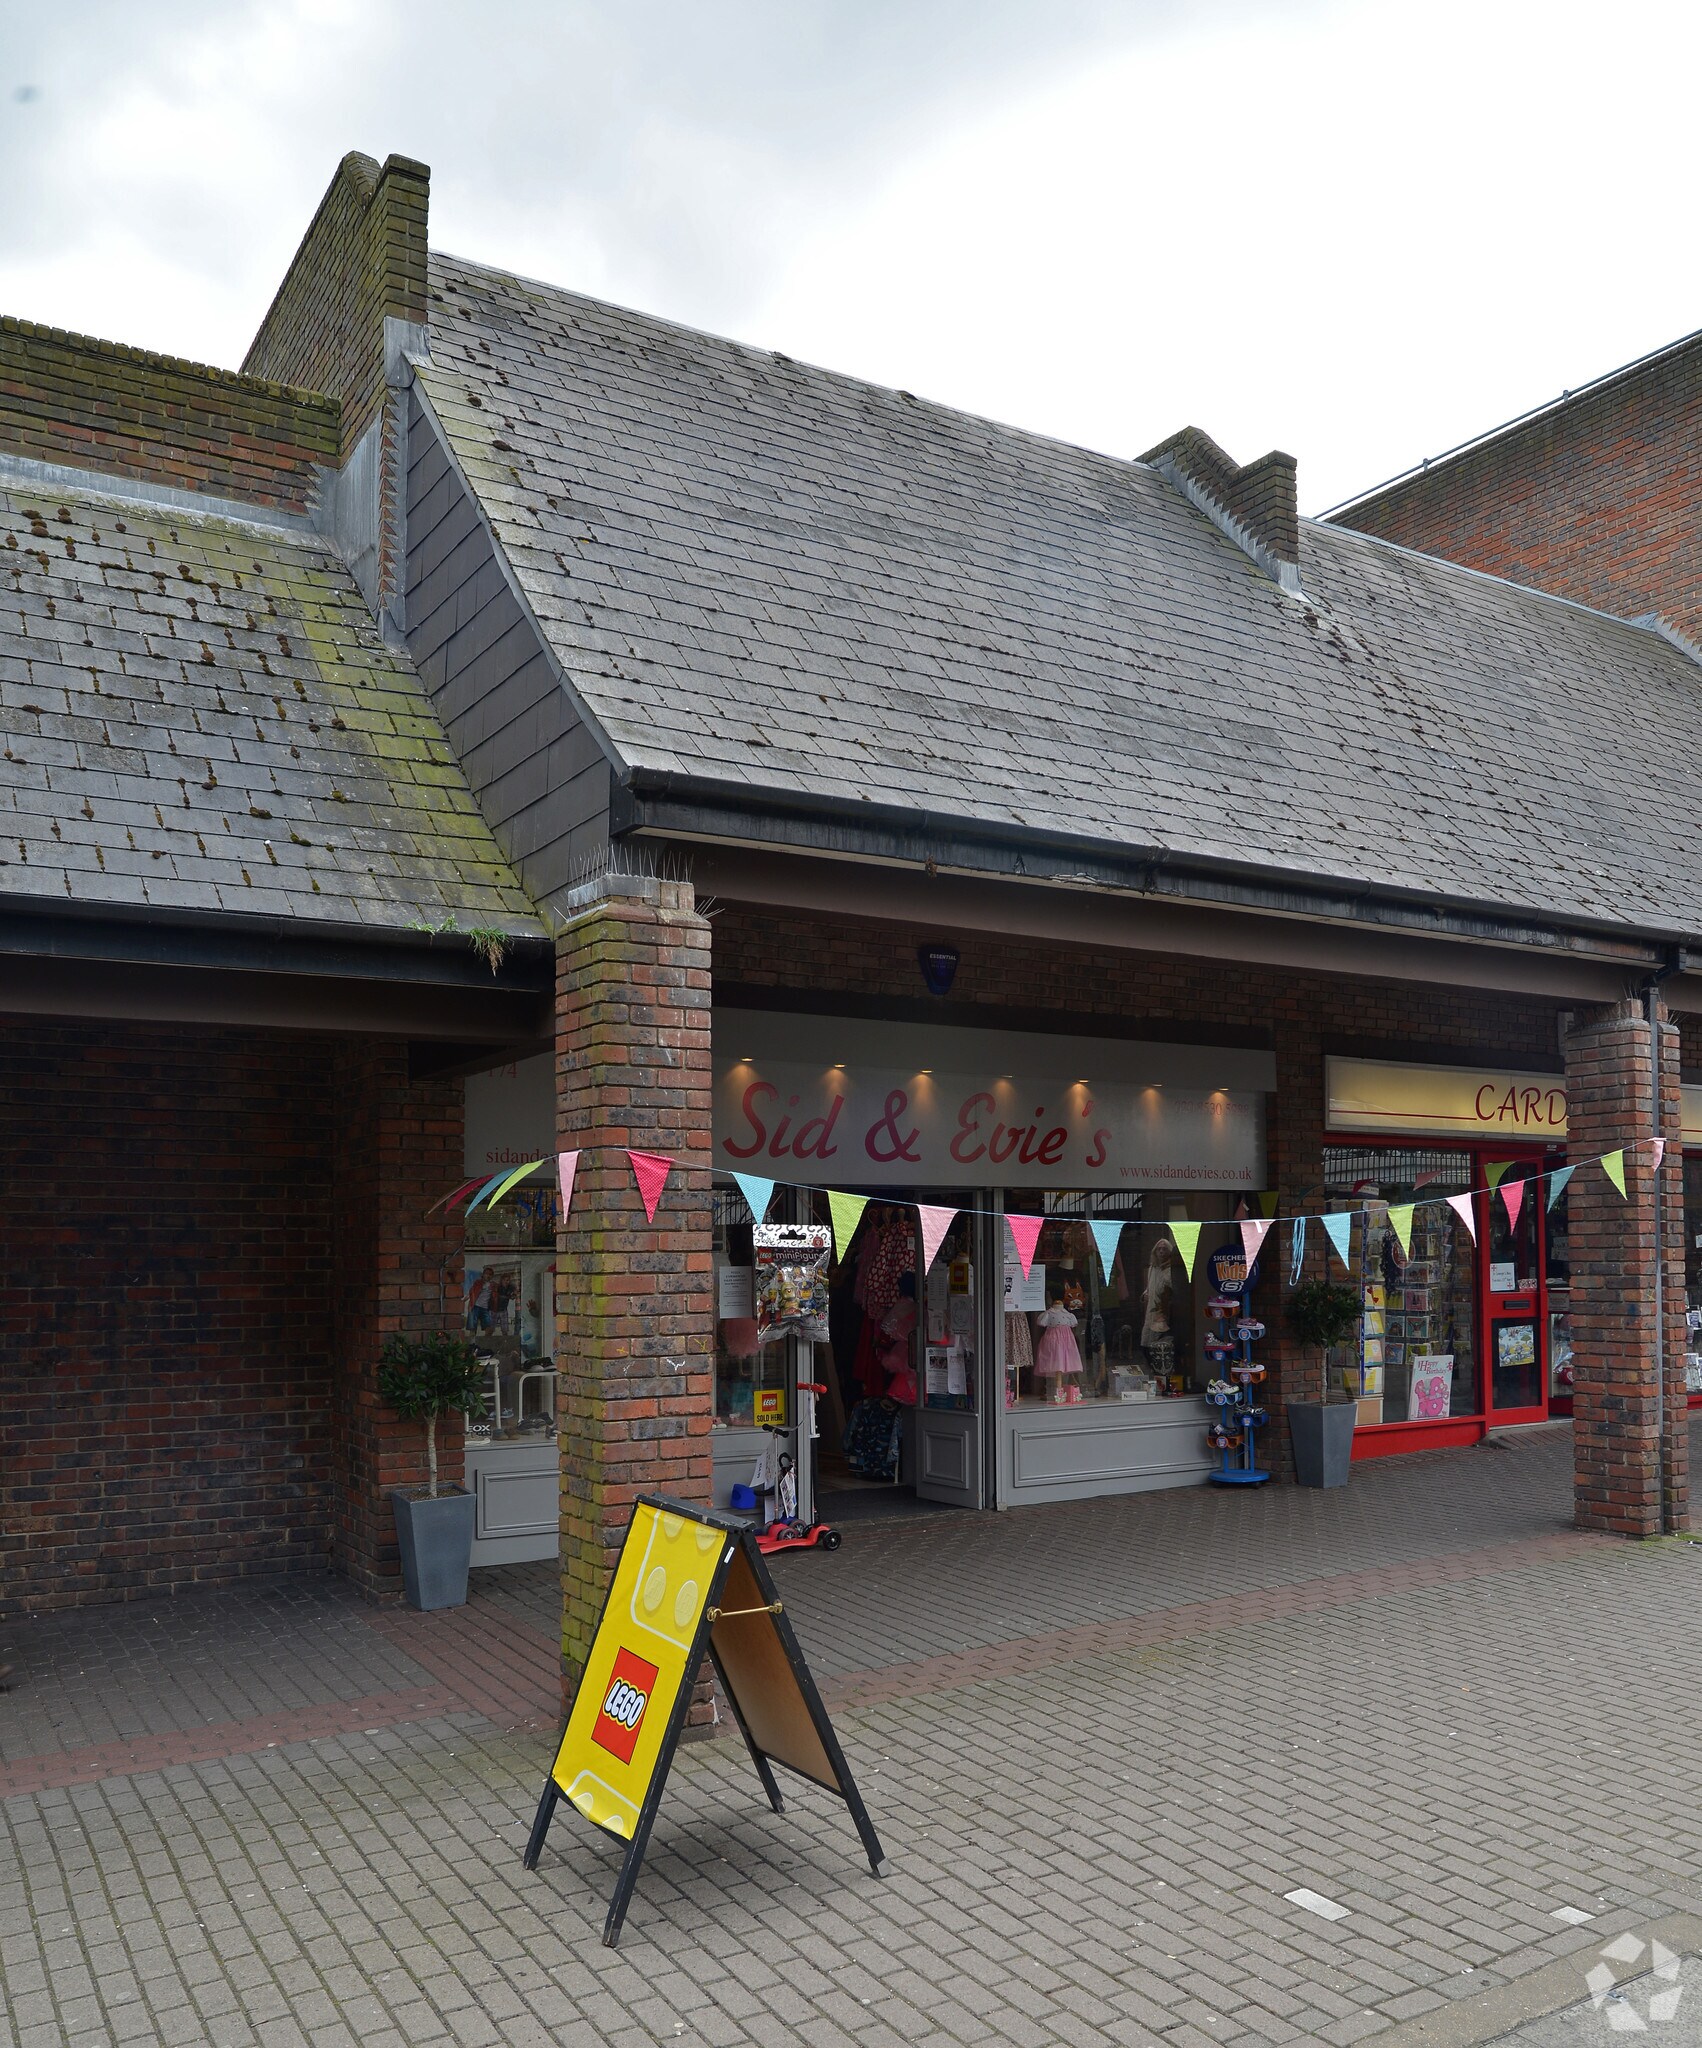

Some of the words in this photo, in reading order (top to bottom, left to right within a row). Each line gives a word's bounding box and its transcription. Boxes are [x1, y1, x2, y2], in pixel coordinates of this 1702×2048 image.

[723, 1081, 845, 1160] Sid
[864, 1089, 922, 1163] &
[949, 1091, 1112, 1168] Evie's
[1120, 1164, 1253, 1181] www.sidandevies.co.uk
[1215, 1261, 1247, 1281] Kids
[757, 1414, 770, 1422] SOLD
[771, 1413, 783, 1421] HERE
[604, 1677, 647, 1731] LEGO
